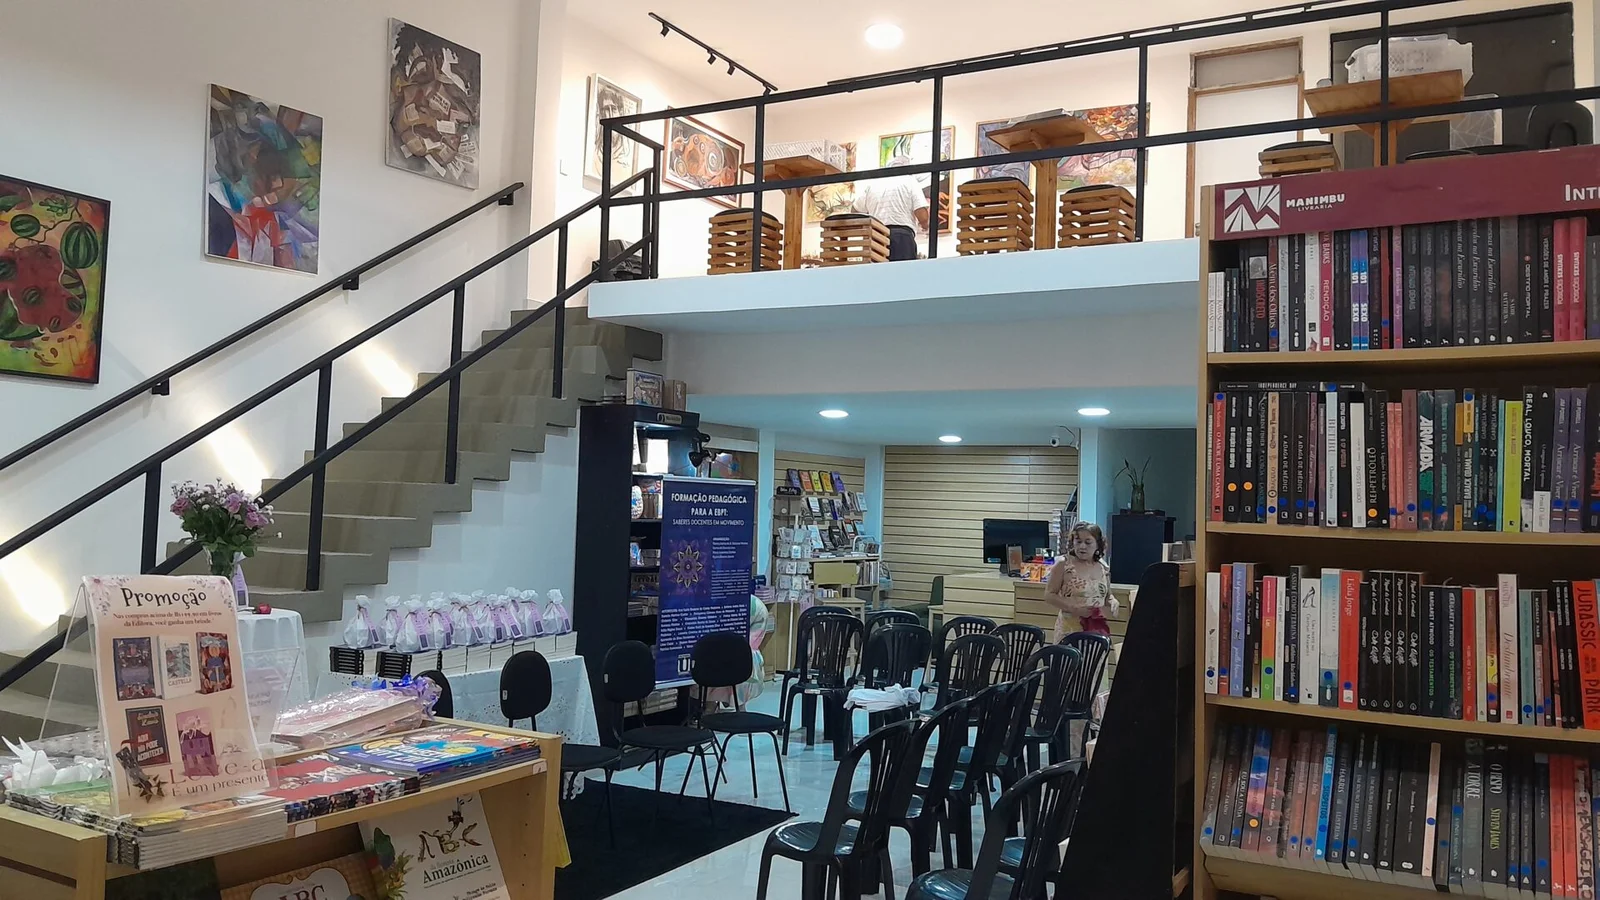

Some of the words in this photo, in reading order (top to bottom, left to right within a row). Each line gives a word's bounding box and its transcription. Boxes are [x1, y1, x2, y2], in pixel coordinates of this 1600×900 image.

[1286, 193, 1345, 208] MANIMBU
[1565, 184, 1600, 201] INT
[1297, 204, 1333, 212] LIVRARIA
[1322, 243, 1330, 264] BANKS
[1457, 254, 1466, 288] Escuridão
[1473, 256, 1481, 290] Escuridão
[1488, 258, 1496, 293] Escuridão
[1269, 288, 1277, 302] dos
[1323, 280, 1331, 321] RENDIÇÃO
[1269, 304, 1277, 328] Olhos
[1525, 393, 1533, 416] REAL,
[1419, 415, 1433, 472] ARMADA
[1523, 418, 1532, 448] LOUCO,
[1283, 461, 1288, 469] DE
[1297, 461, 1303, 469] DE
[1464, 459, 1472, 477] OBAMA
[1523, 450, 1531, 482] MORTAL
[671, 493, 707, 503] FORMAÇÃO
[708, 494, 747, 503] PEDAGÓGICA
[1464, 478, 1472, 499] BARACK
[1555, 480, 1563, 499] Viver
[1571, 480, 1579, 499] Viver
[691, 508, 707, 516] PARA
[708, 508, 713, 516] A
[121, 587, 207, 609] Promoção
[1344, 596, 1354, 616] Jorge
[1577, 588, 1596, 649] JURASSIC
[1585, 679, 1600, 713] PARK
[1241, 771, 1247, 779] EU
[1325, 757, 1333, 773] CRAIS
[186, 784, 208, 794] um
[1338, 769, 1346, 793] HARRIS
[1465, 772, 1480, 799] TORRE
[1490, 772, 1502, 794] BISPO
[1236, 798, 1244, 818] LENDA
[1320, 785, 1330, 819] SUSPEITOS
[1490, 808, 1501, 830] STEVEN
[1490, 831, 1500, 849] JAMES
[423, 854, 489, 884] Amazônica
